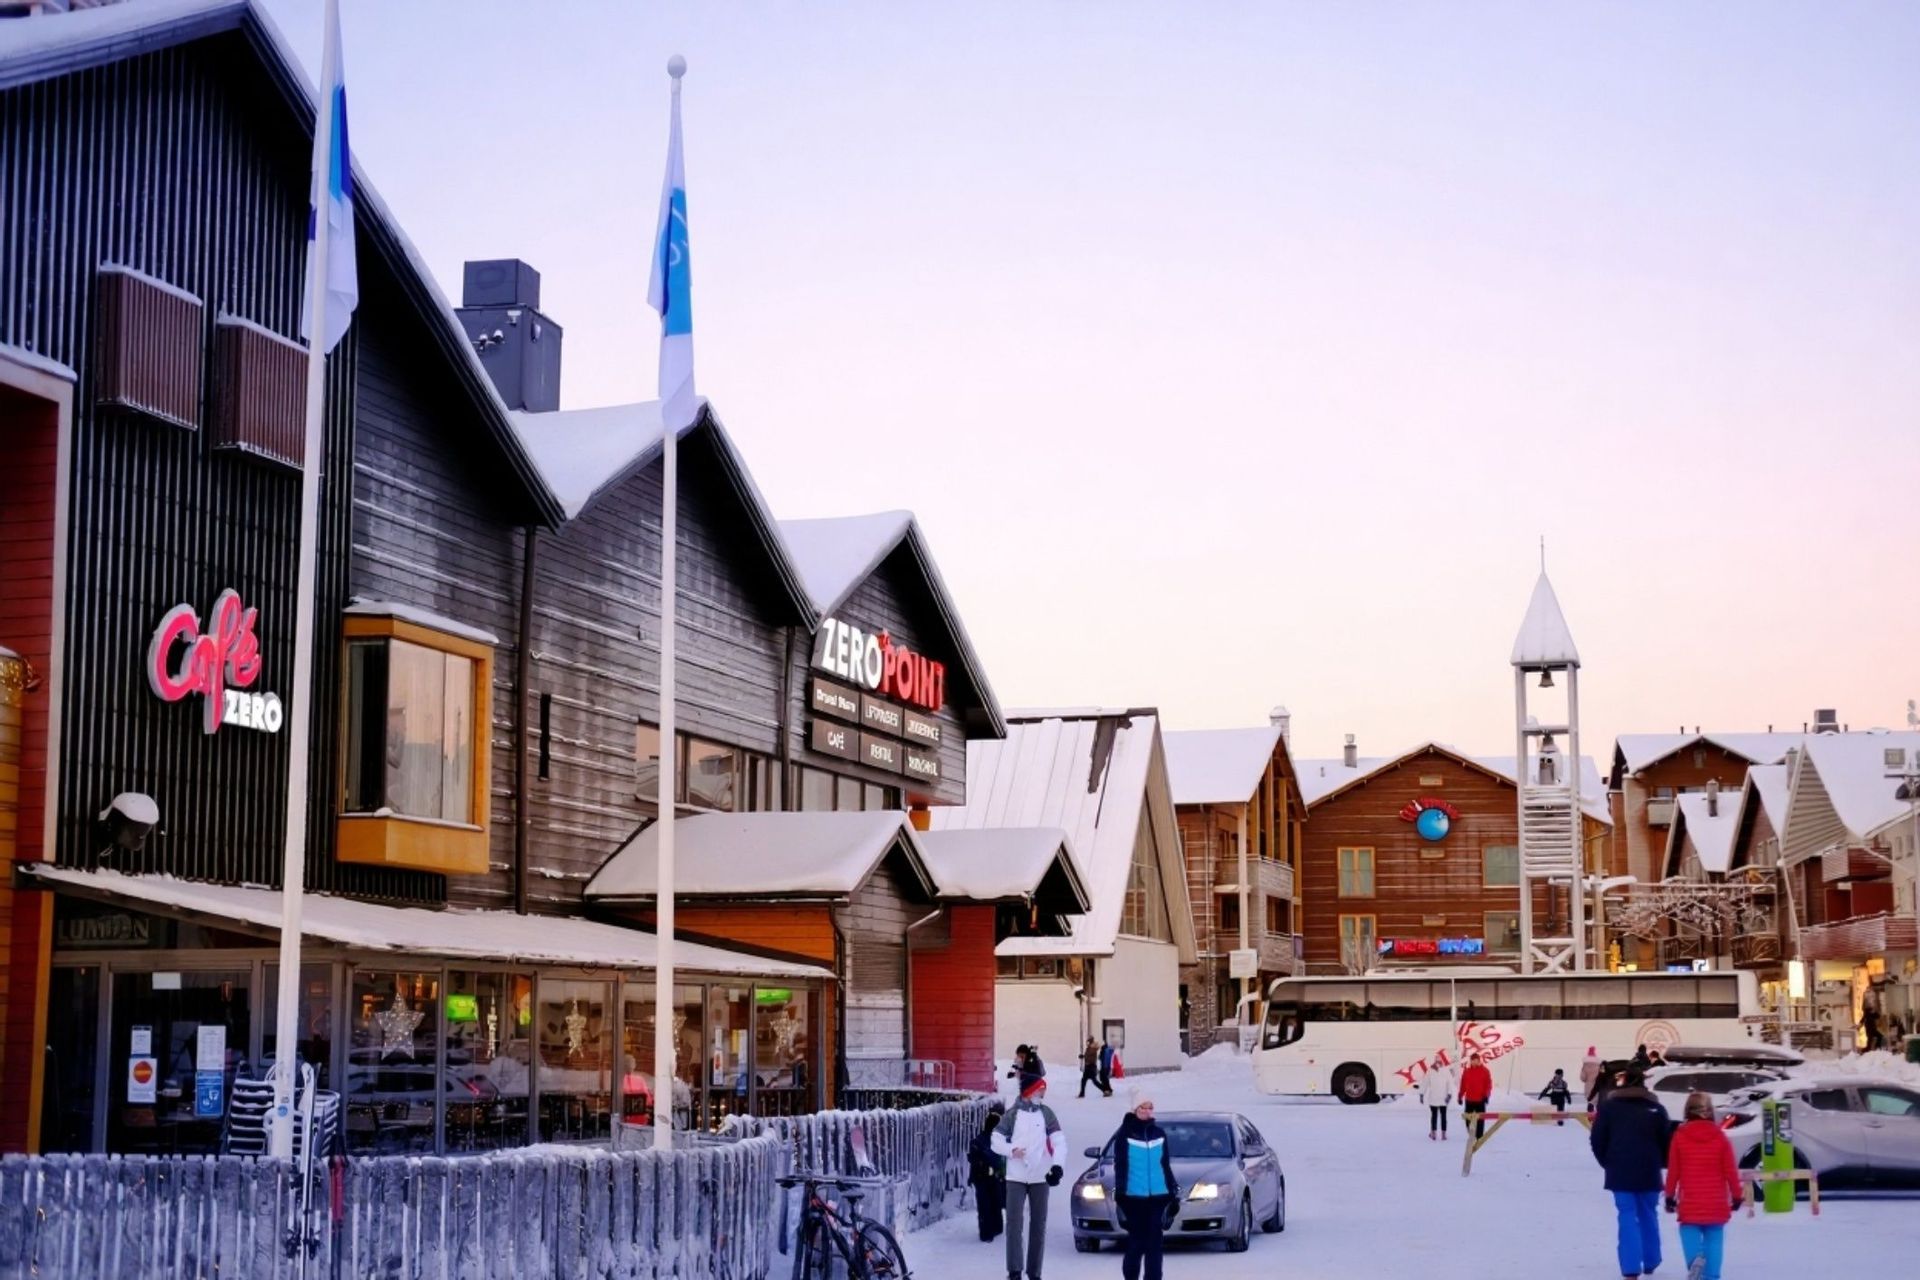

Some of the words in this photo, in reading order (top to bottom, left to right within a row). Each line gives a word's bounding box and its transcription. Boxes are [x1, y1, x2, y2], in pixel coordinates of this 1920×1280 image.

[149, 589, 262, 734] Café
[817, 617, 882, 690] ZERO
[882, 642, 945, 712] POINT
[223, 688, 282, 732] ZERO
